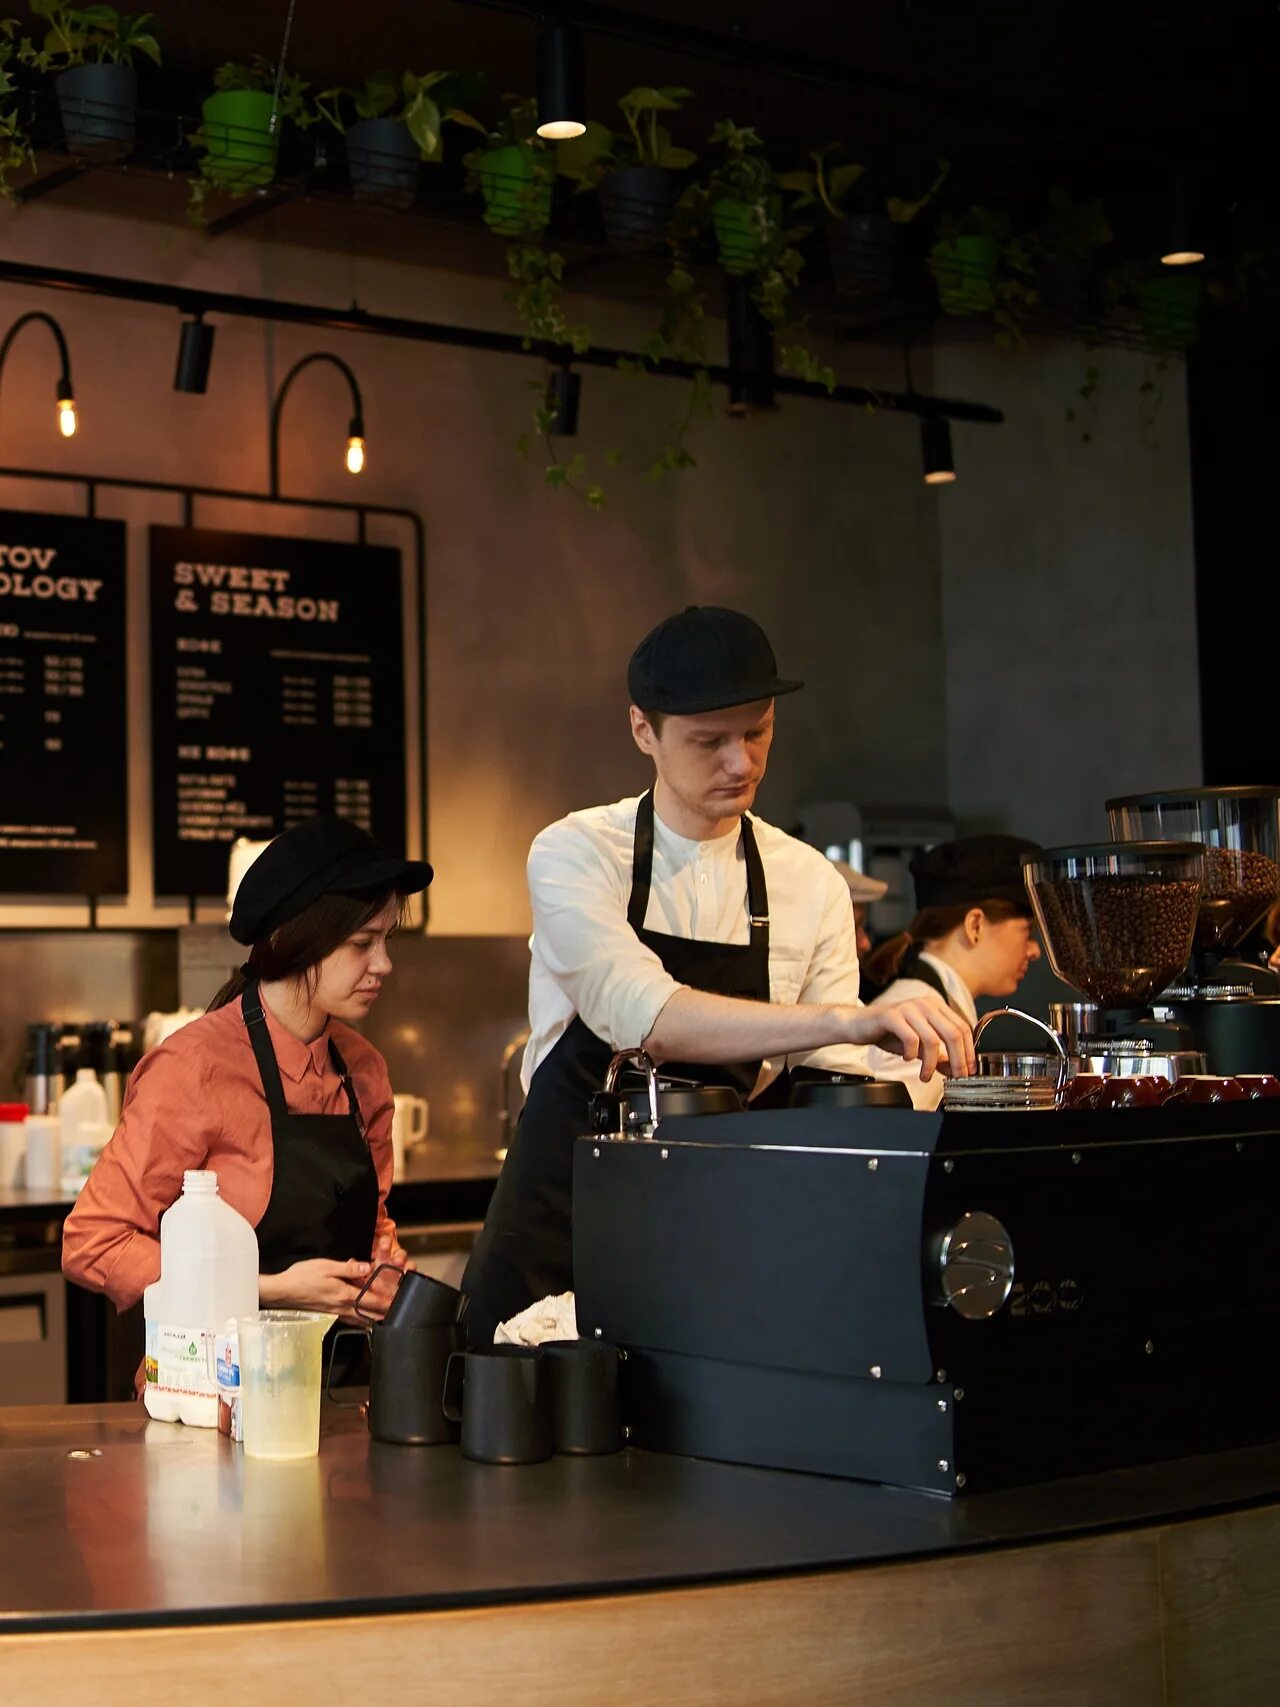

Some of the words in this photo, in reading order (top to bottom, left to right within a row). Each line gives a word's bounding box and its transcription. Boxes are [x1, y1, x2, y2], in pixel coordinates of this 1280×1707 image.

[174, 562, 290, 592] SWEET
[175, 589, 199, 613] &
[211, 593, 339, 622] SEASON
